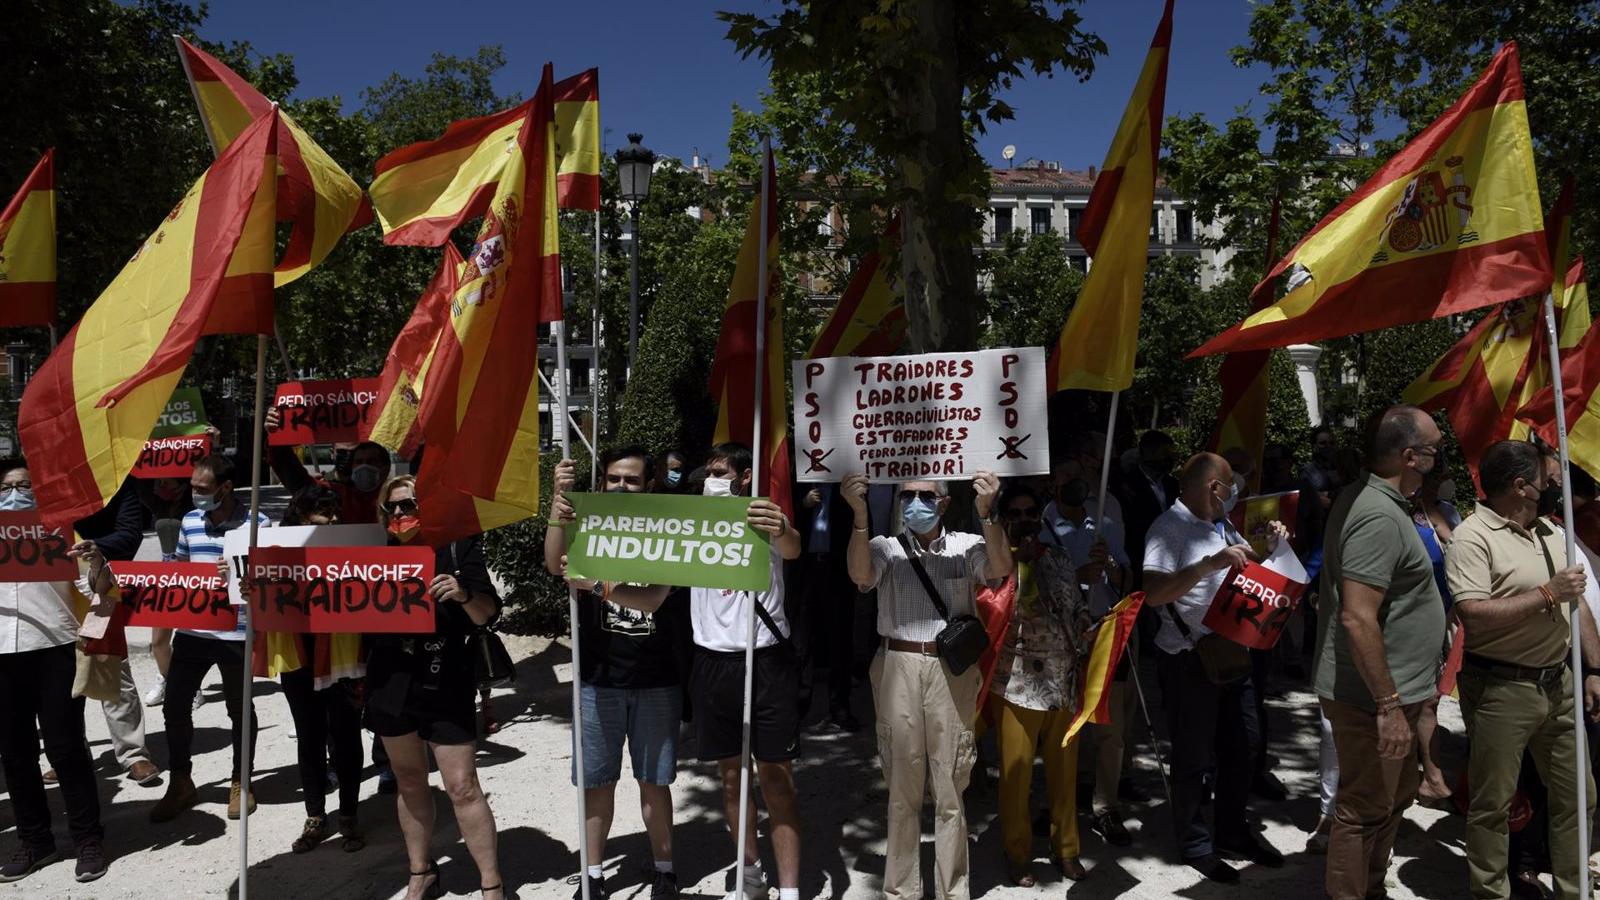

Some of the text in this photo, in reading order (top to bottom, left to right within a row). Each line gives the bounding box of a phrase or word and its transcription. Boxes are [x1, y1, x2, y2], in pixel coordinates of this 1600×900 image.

[167, 400, 190, 412] LOS
[277, 393, 325, 407] PEDRO
[855, 381, 964, 411] LADRONES
[152, 438, 204, 451] SÁNCHEZ
[855, 427, 969, 446] ESTAFADORES
[137, 447, 207, 470] AIDOR
[859, 442, 963, 460] PEDRO SANCHEZ
[580, 514, 746, 539] ¡PAREMOS LOS
[586, 533, 754, 567] INDULTOS!
[254, 563, 323, 582] PEDRO
[325, 561, 425, 582] SÁNCHEZ
[120, 584, 236, 616] RAIDOR
[253, 576, 430, 616] TRAIDOR
[1233, 573, 1292, 609] PEDRO
